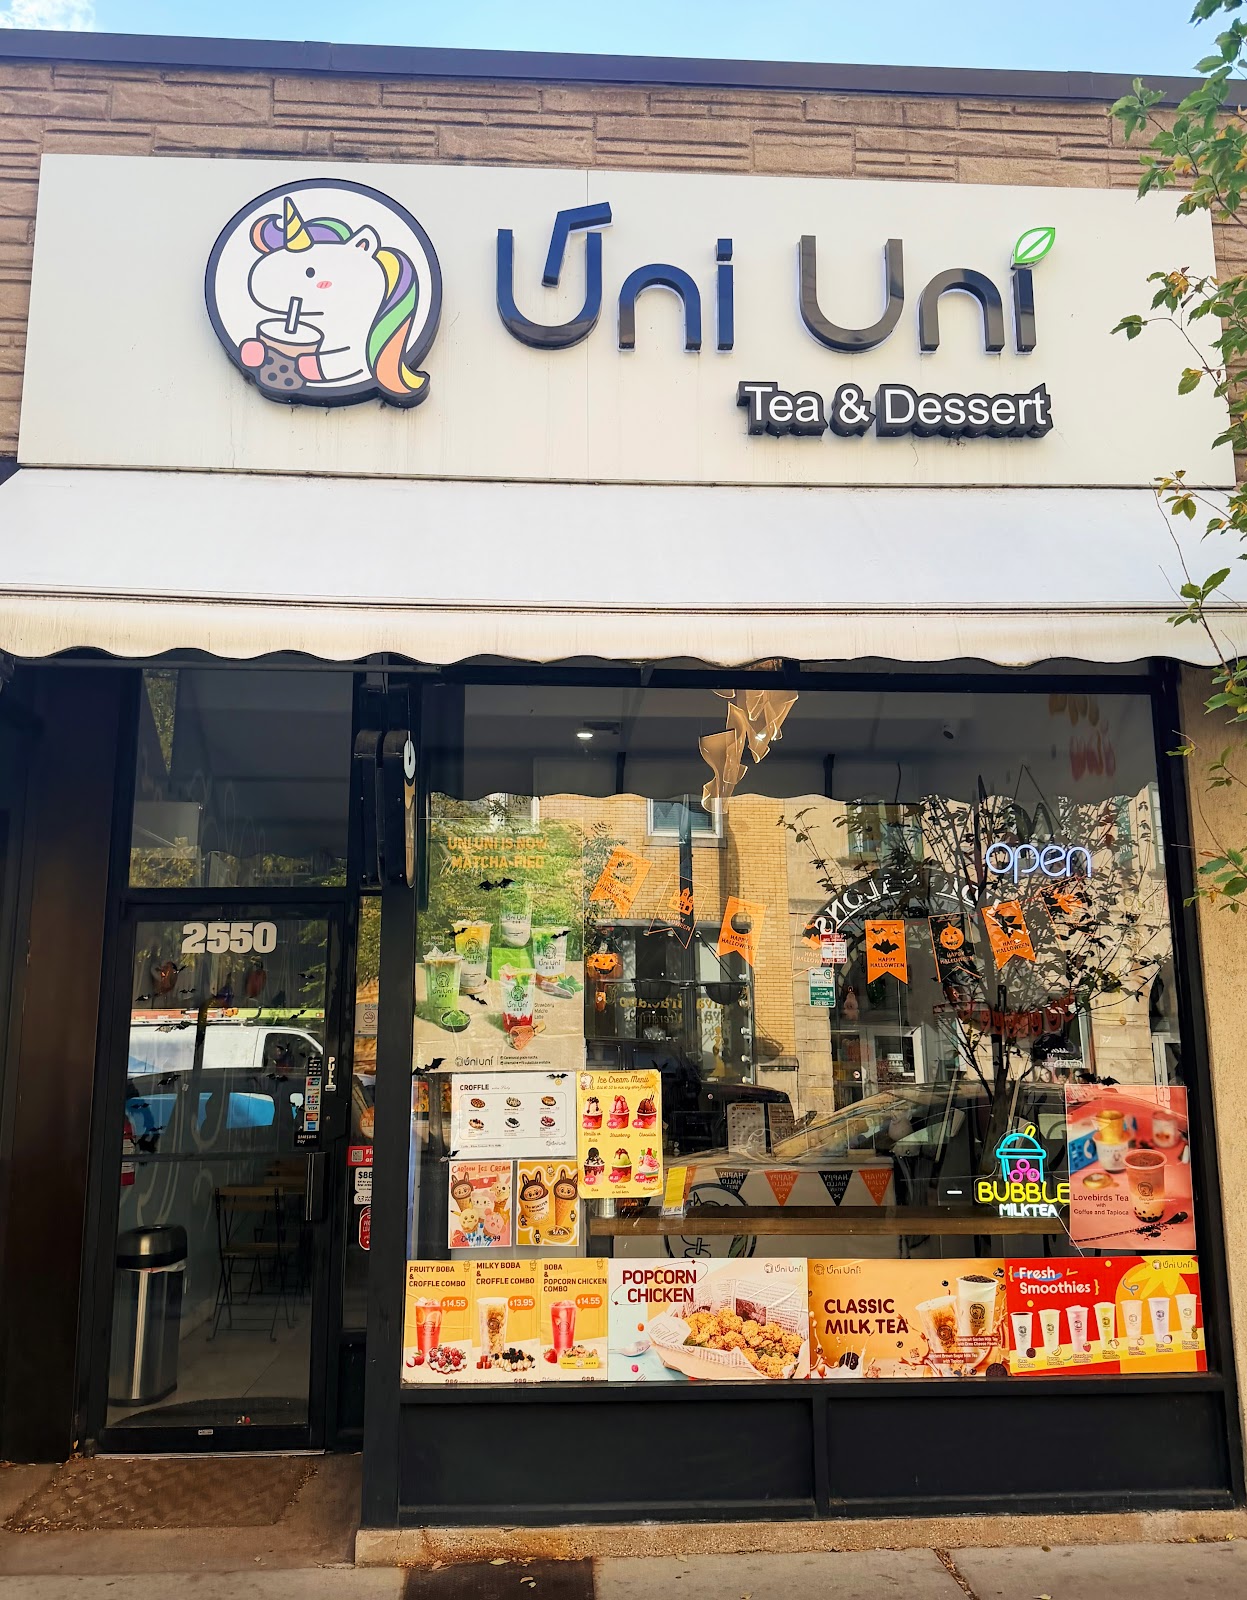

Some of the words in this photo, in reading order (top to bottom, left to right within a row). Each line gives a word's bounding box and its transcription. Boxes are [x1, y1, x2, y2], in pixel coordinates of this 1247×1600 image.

[744, 386, 820, 422] Tea
[838, 387, 870, 424] &
[885, 388, 1047, 425] Dessert
[516, 836, 548, 850] NOW
[451, 855, 545, 869] MATCHA-FIED
[985, 842, 1092, 884] open
[181, 921, 278, 954] 2550
[730, 934, 749, 943] HAPPY
[996, 942, 1030, 954] HALLOWEEN
[327, 1056, 336, 1086] PULL
[597, 1076, 607, 1084] Ice
[608, 1076, 630, 1084] Cream
[630, 1075, 650, 1084] Menu
[490, 1164, 511, 1172] CREAM
[977, 1181, 1070, 1203] BUBBLE
[1073, 1193, 1113, 1202] Lovebirds
[1114, 1194, 1129, 1202] Tea
[1107, 1209, 1129, 1217] Tapioca
[409, 1265, 435, 1273] FRUITY
[436, 1265, 455, 1273] BOBA
[1019, 1266, 1056, 1280] Fresh
[510, 1277, 535, 1285] COMBO
[622, 1269, 697, 1285] POPCORN
[627, 1287, 694, 1303] CHICKEN
[1019, 1281, 1091, 1295] Smoothies
[509, 1299, 534, 1307] $13.95
[577, 1297, 601, 1305] $14.55
[824, 1298, 895, 1314] CLASSIC
[825, 1319, 870, 1335] MILK
[875, 1318, 909, 1334] TEA
